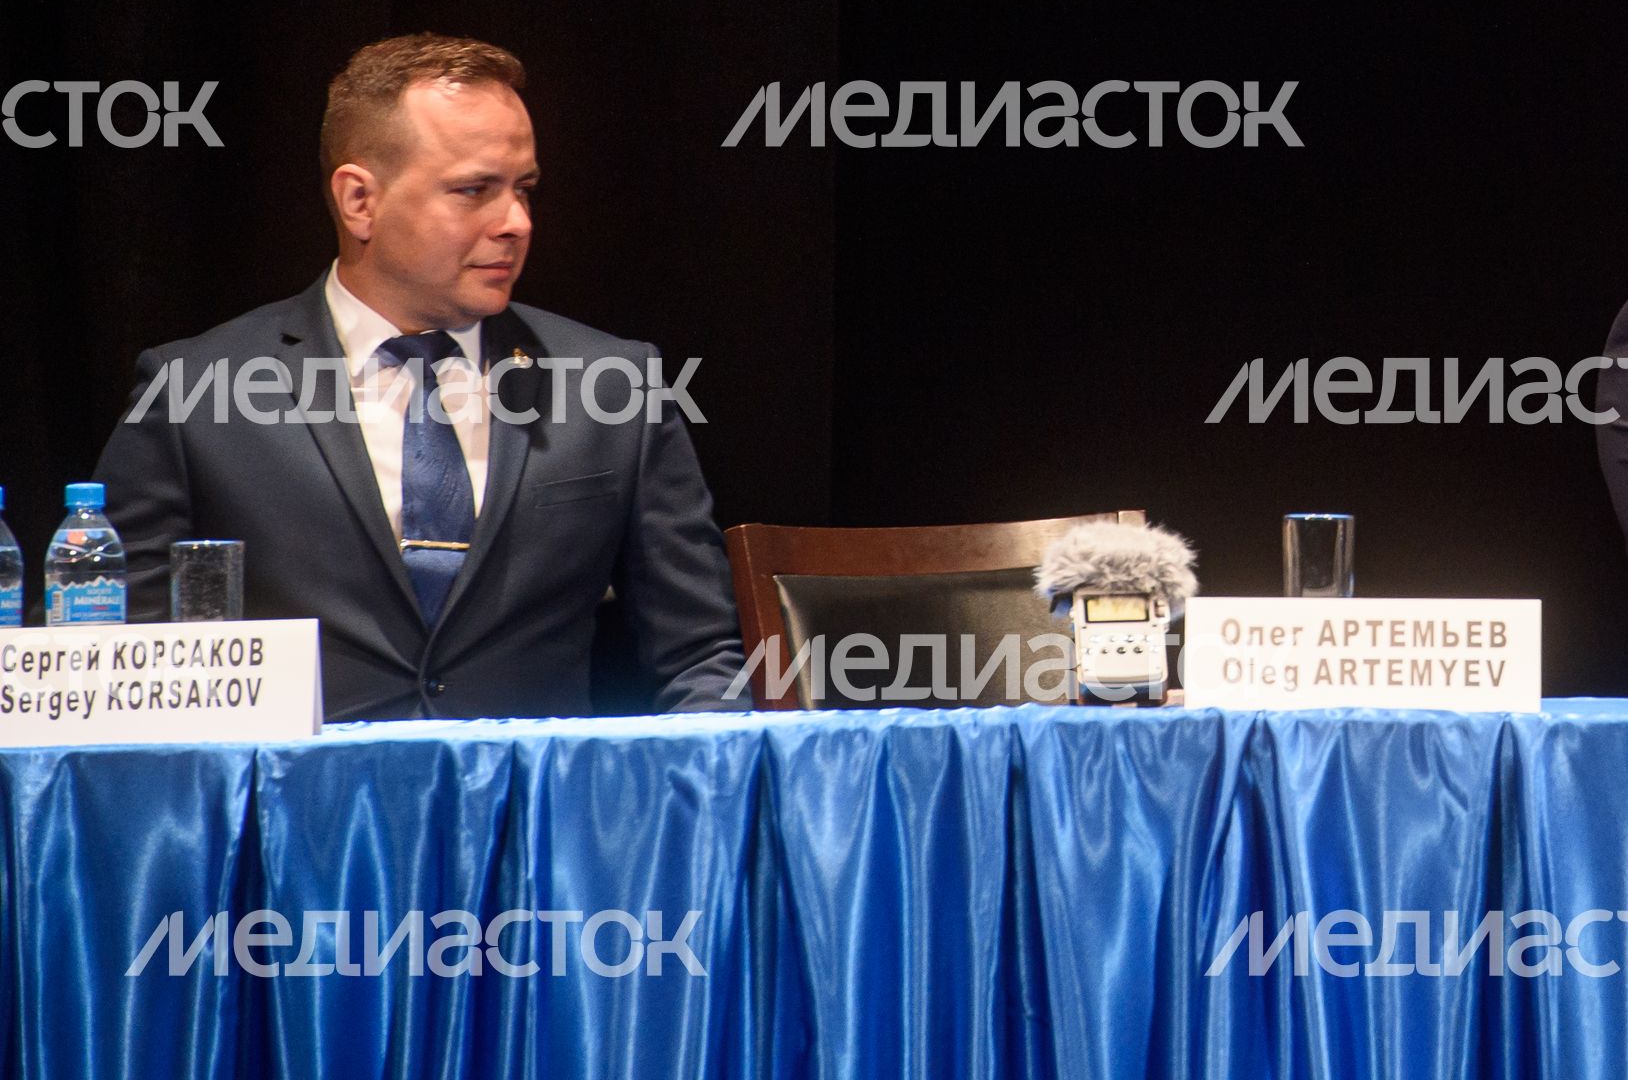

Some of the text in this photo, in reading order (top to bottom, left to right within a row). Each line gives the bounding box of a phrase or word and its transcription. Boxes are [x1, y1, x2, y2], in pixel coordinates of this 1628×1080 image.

[1221, 618, 1507, 648] Олег АРТЕМЬЕВ
[1, 638, 264, 680] Сергей КОРСАКОВ
[1222, 657, 1506, 692] Oleg ARTEMYEV
[0, 677, 263, 721] Sergey KORSAKOV
